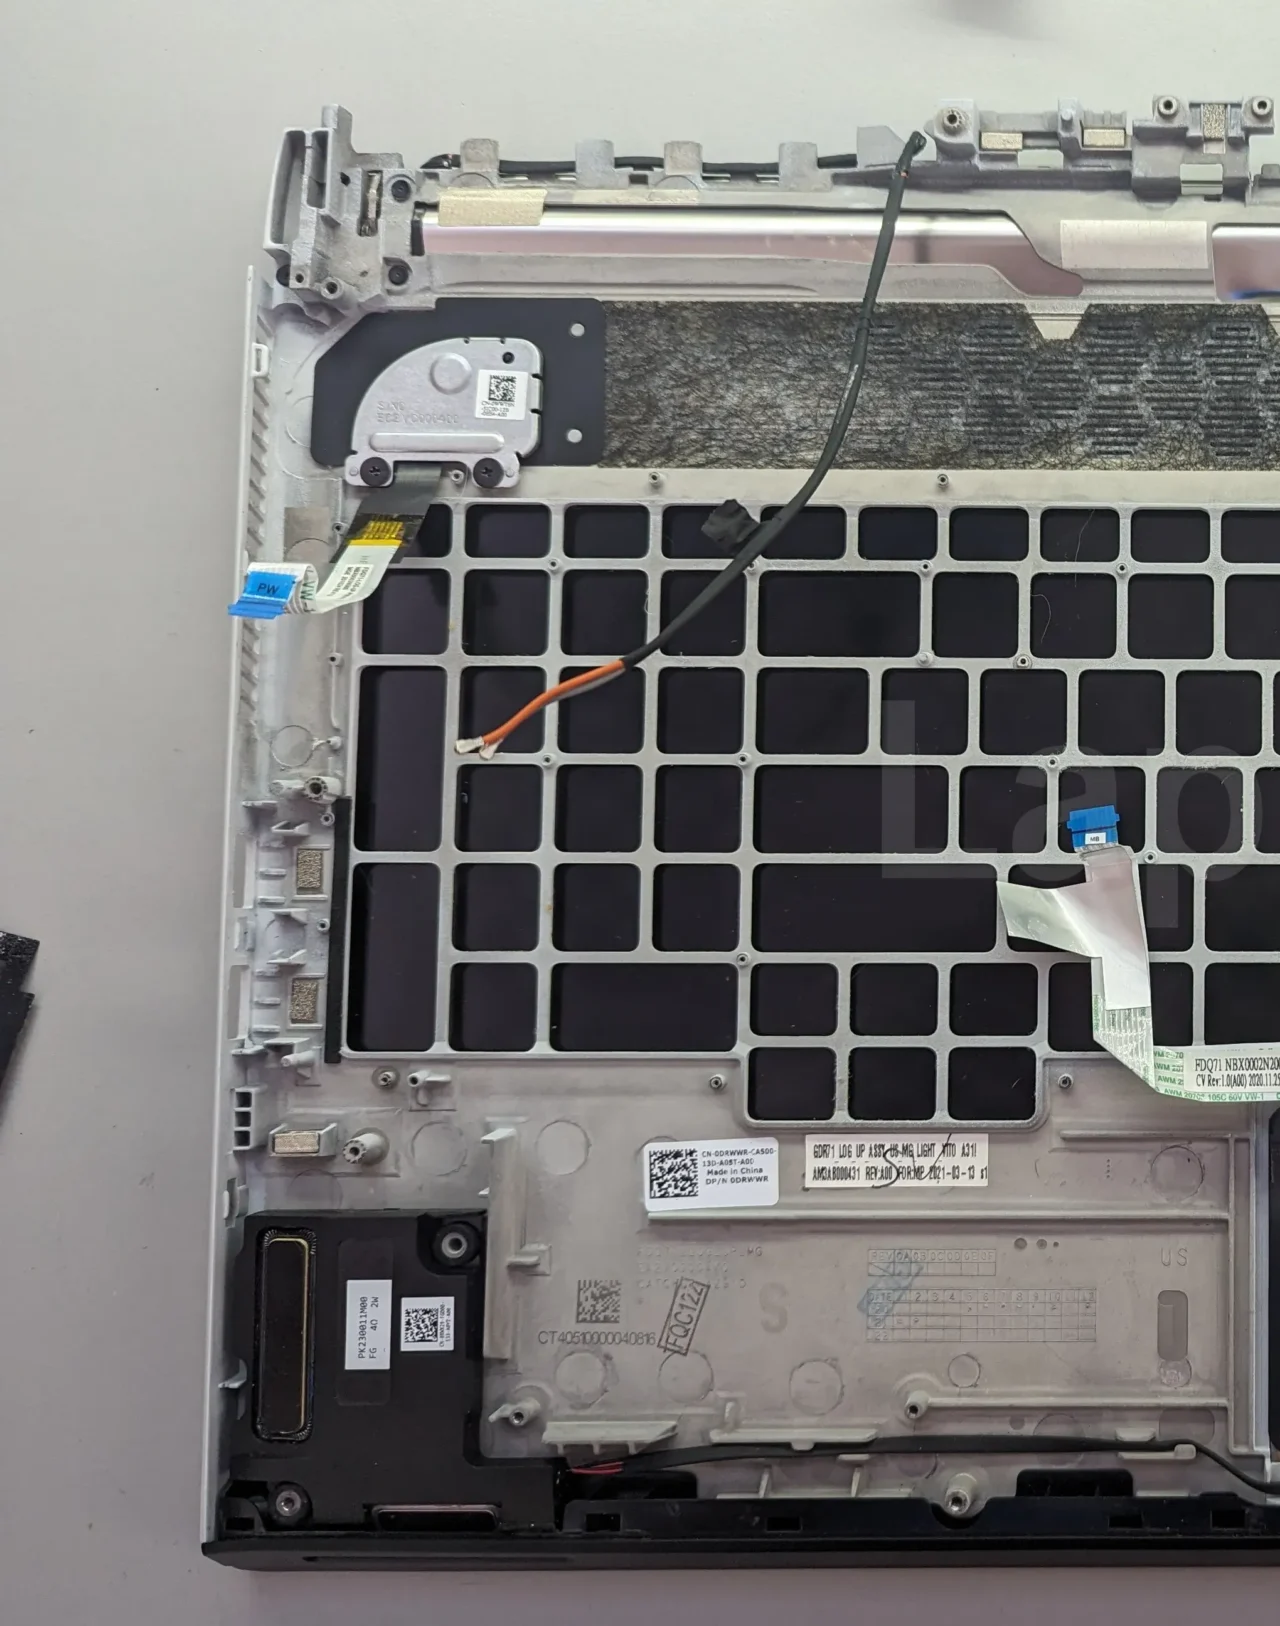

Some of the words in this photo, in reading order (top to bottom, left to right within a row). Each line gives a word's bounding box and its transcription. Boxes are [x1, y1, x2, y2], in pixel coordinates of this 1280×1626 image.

[257, 582, 280, 595] PW
[1194, 1057, 1223, 1074] FDQ71
[1196, 1075, 1207, 1087] CV
[813, 1143, 836, 1159] GDR71
[838, 1143, 853, 1158] LOG
[856, 1143, 866, 1158] UP
[916, 1143, 937, 1159] LIGHT
[706, 1168, 729, 1177] Made
[740, 1166, 764, 1175] China
[929, 1165, 976, 1181] 2021-03-13
[705, 1177, 728, 1186] DP/N
[730, 1175, 770, 1184] 0DRWWR
[1160, 1247, 1188, 1267] US
[370, 1296, 379, 1308] 2W
[368, 1347, 378, 1359] FG
